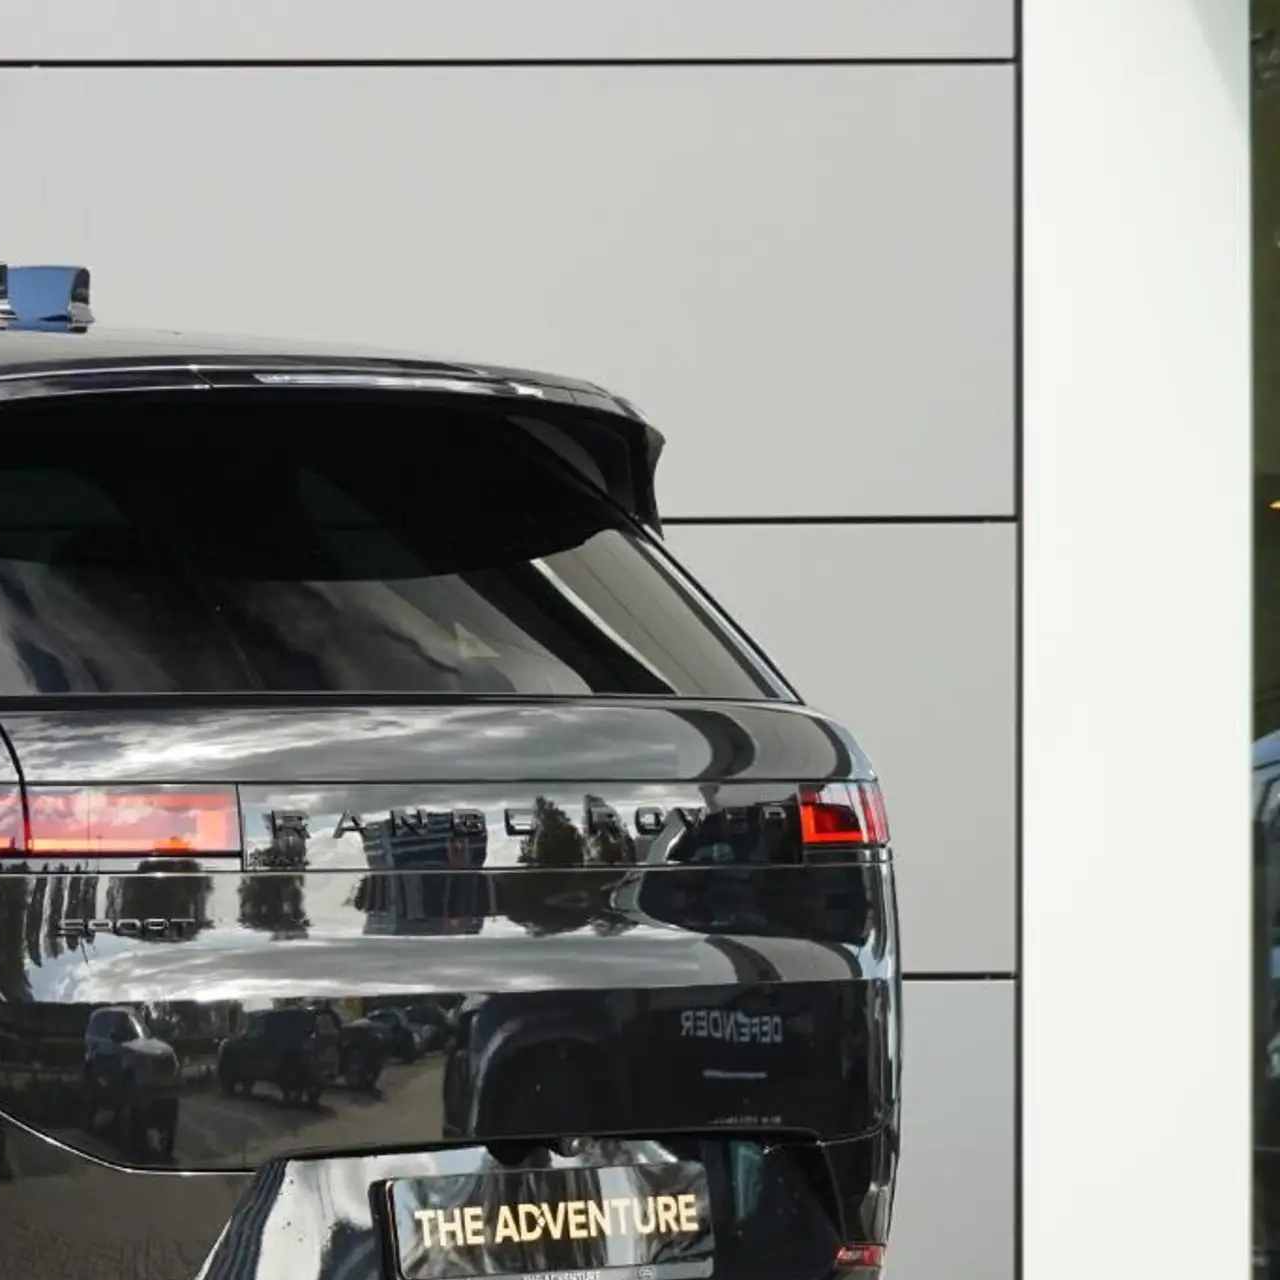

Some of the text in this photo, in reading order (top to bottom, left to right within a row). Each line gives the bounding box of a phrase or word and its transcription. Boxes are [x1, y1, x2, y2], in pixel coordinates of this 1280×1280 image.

[271, 808, 538, 839] RANGE
[414, 1194, 700, 1248] THE ADVENTURE
